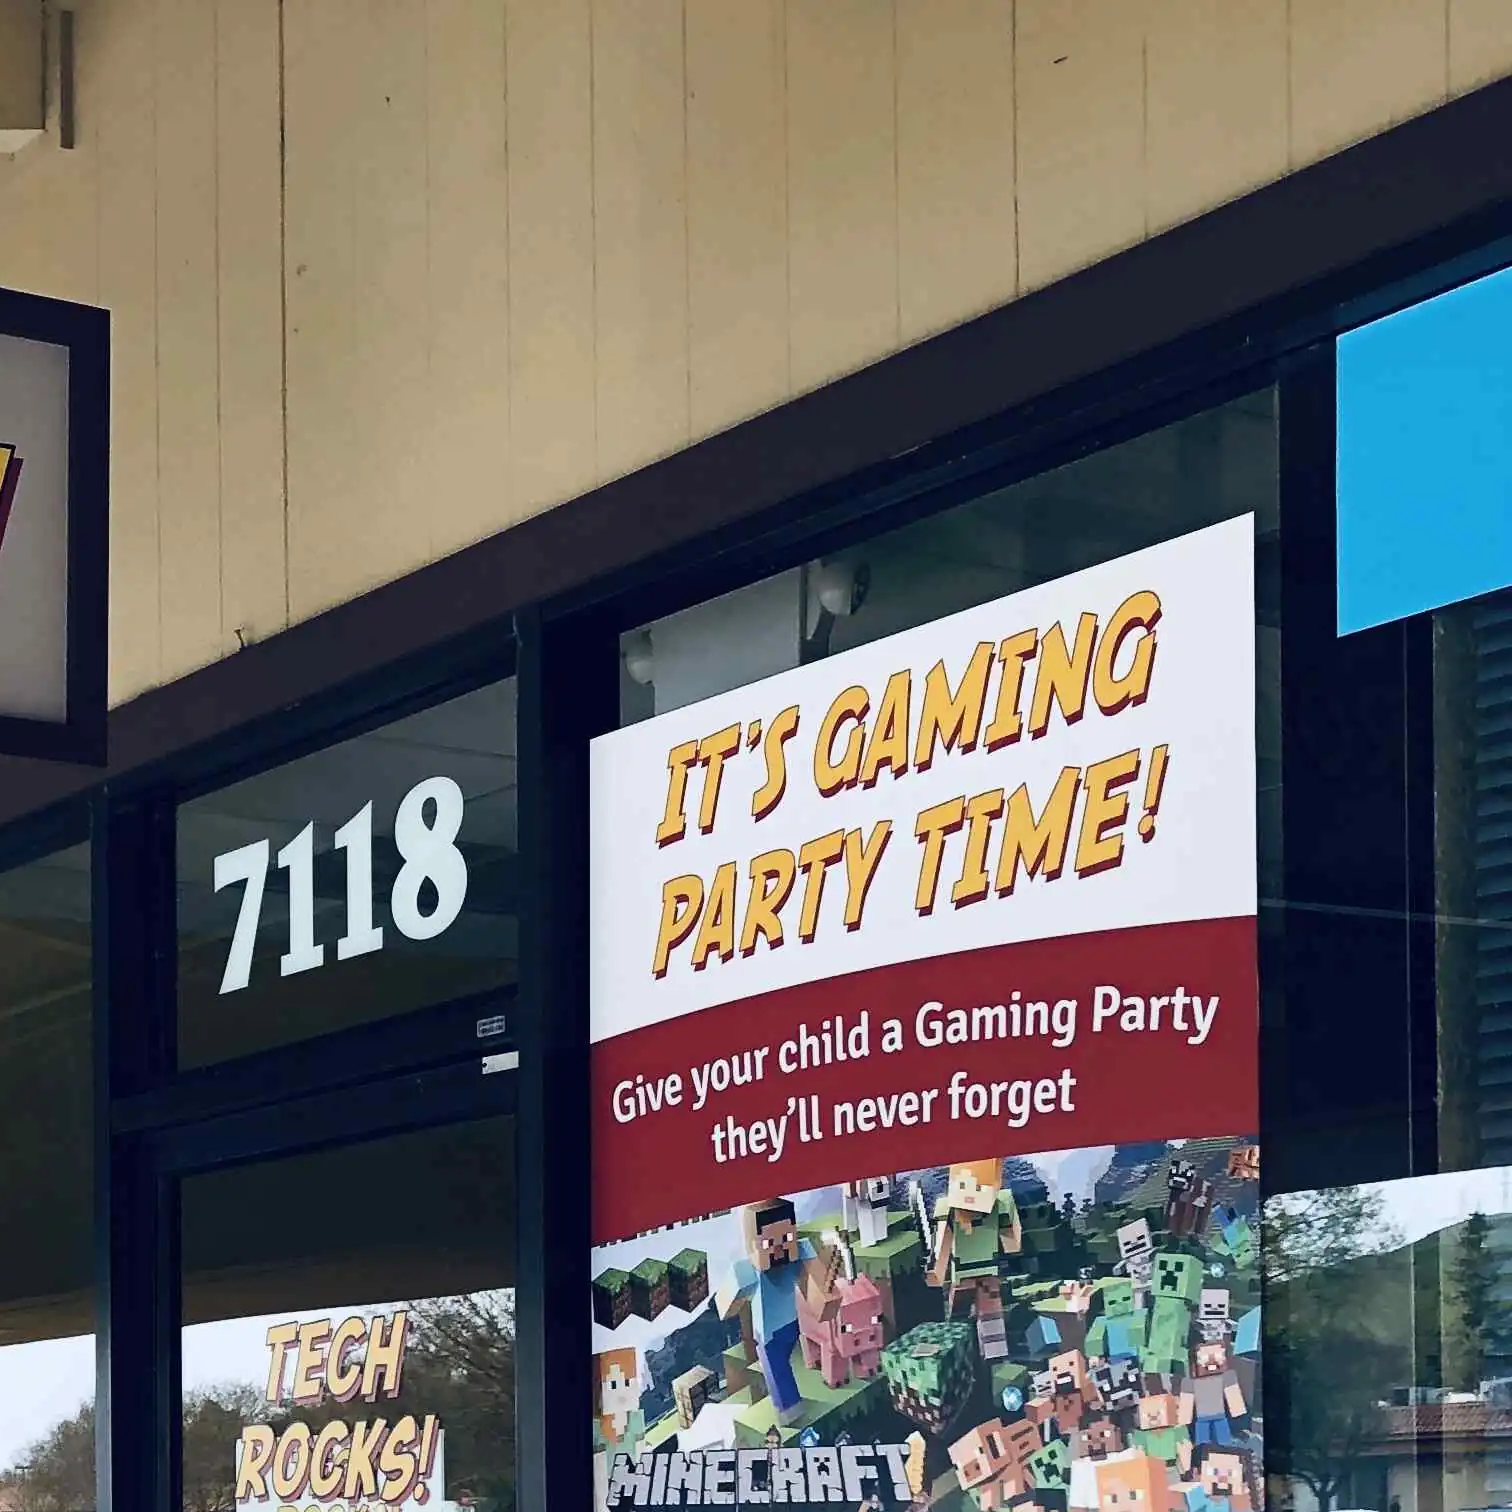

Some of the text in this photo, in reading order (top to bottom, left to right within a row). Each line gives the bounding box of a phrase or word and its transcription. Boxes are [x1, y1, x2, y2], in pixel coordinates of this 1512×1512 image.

[655, 590, 1163, 848] IT'S GAMING
[214, 776, 468, 995] 7118
[651, 743, 1169, 980] PARTY TIME!
[612, 984, 1220, 1124] Give your child a Gaming Party
[711, 1068, 1077, 1164] they'll never forget
[266, 1310, 411, 1408] TECH
[235, 1414, 439, 1506] ROCKS!
[606, 1442, 915, 1508] MINECRAFT
